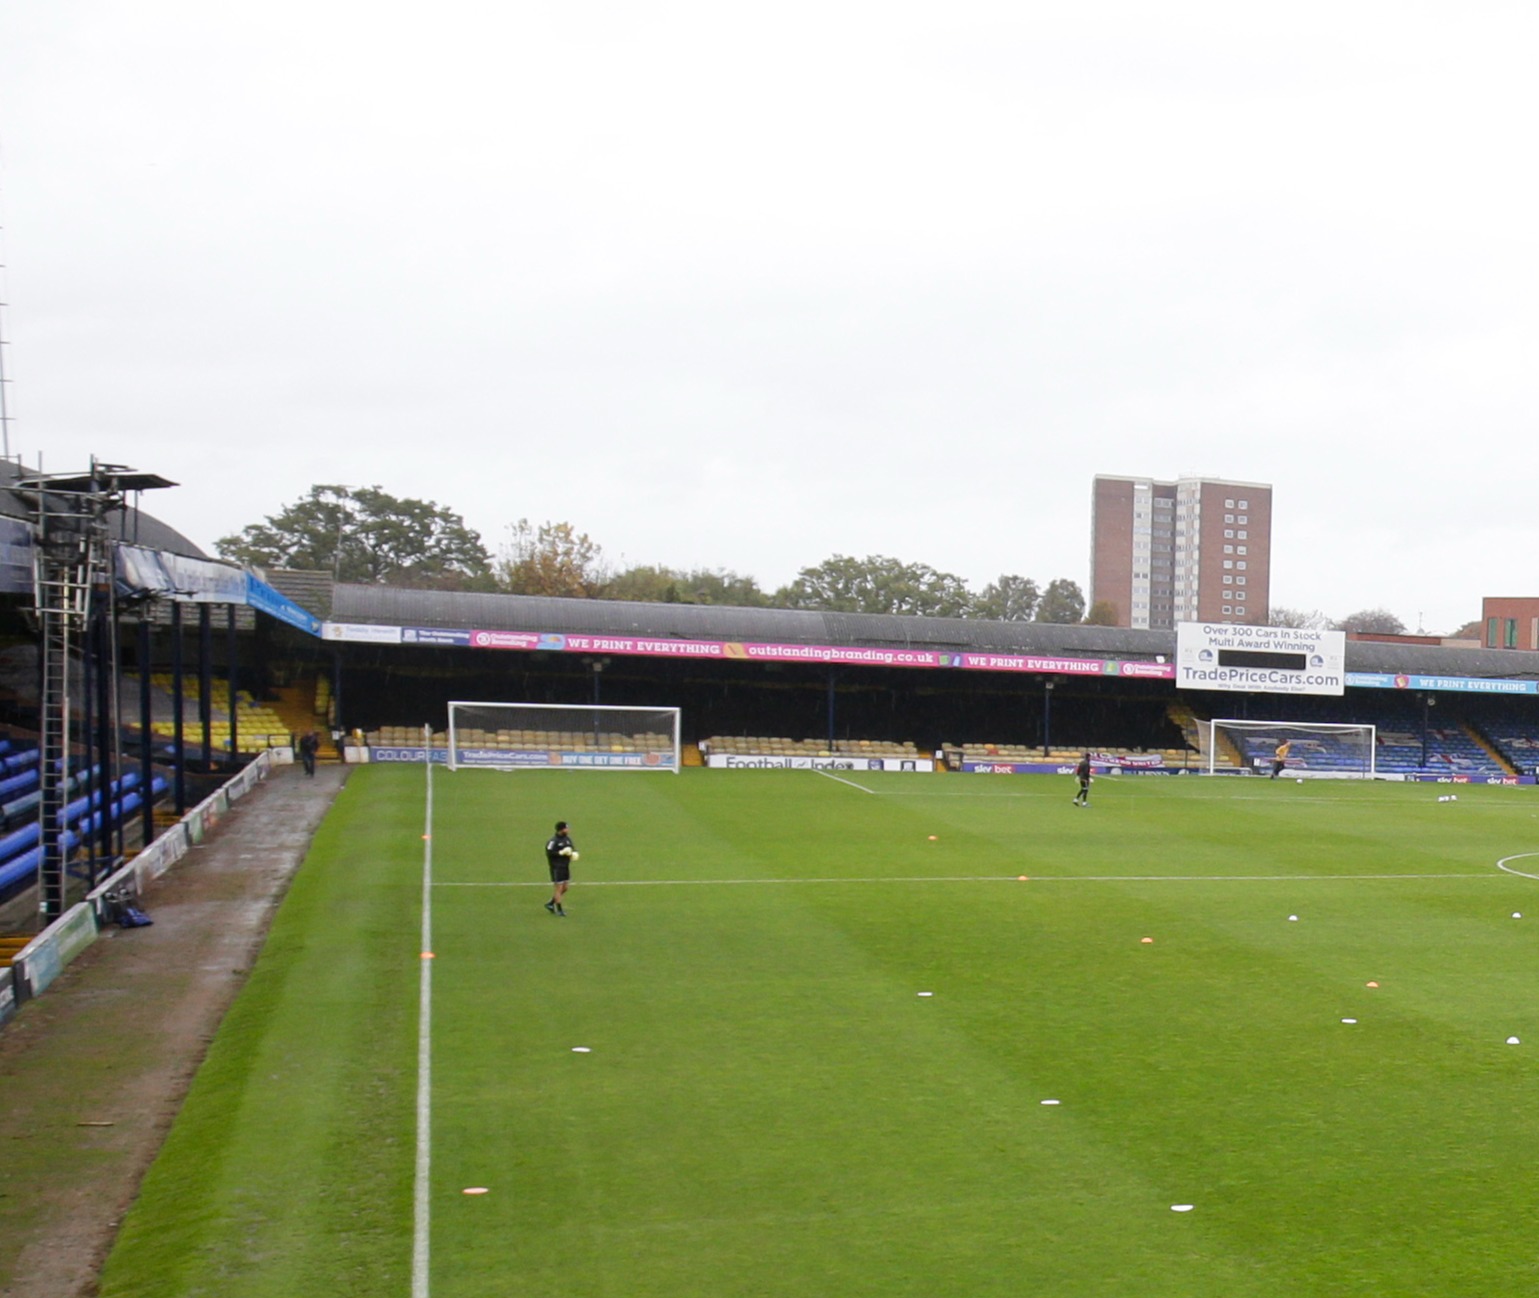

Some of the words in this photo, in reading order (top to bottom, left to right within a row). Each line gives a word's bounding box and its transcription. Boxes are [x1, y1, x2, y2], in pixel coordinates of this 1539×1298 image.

[1203, 625, 1228, 635] Over
[1232, 626, 1253, 636] 300
[1256, 628, 1278, 638] Cars
[1281, 630, 1291, 639] In
[1293, 630, 1321, 641] Stock
[568, 638, 589, 648] WE
[593, 640, 632, 650] PRINT
[637, 642, 720, 654] EVERYTHING
[1209, 637, 1235, 646] Multi
[1237, 639, 1270, 649] Award
[1273, 641, 1315, 652] Winning
[749, 645, 934, 664] outstandingbranding.co.uk
[968, 656, 986, 666] WE
[990, 658, 1024, 668] PRINT
[1027, 660, 1099, 672] EVERYTHING
[1183, 667, 1339, 686] TradePriceCars.com
[1420, 678, 1435, 687] WE
[1437, 680, 1465, 688] PRINT
[1468, 680, 1526, 691] EVERYTHING
[726, 756, 792, 768] Football
[974, 764, 993, 774] sky
[994, 764, 1012, 774] bet
[1057, 767, 1074, 775] sky
